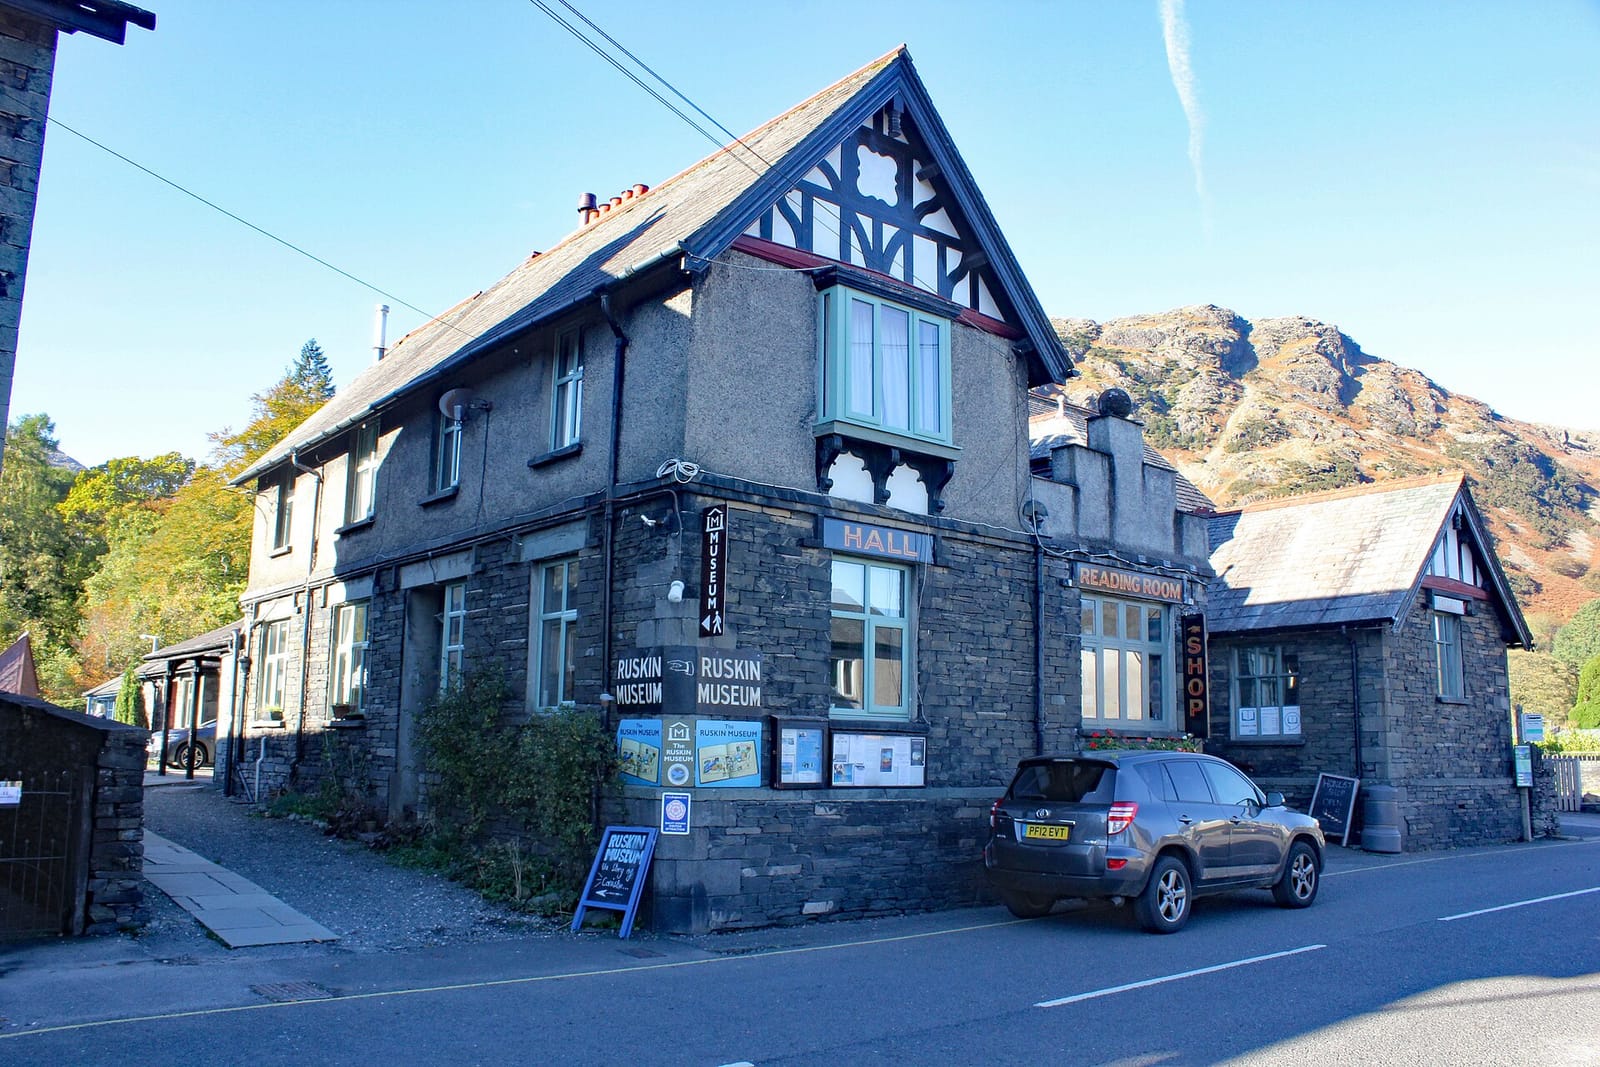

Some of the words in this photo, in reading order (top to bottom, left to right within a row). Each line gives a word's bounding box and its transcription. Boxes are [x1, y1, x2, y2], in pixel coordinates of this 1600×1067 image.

[843, 524, 919, 557] HALL
[708, 531, 718, 610] MUSEUM
[1080, 567, 1141, 592] READING
[1143, 577, 1182, 600] ROOM
[617, 656, 662, 679] RUSKIN
[701, 656, 761, 681] RUSKIN
[1186, 636, 1204, 717] SHOP
[616, 682, 662, 705] MUSEUM
[697, 683, 761, 707] MUSEUM
[700, 729, 727, 737] RUSKIN
[728, 730, 758, 738] MUSEUM
[608, 834, 646, 848] RUSKIN
[1029, 826, 1047, 837] PF12
[1049, 827, 1065, 838] EVT
[604, 849, 644, 864] MUSEUM
